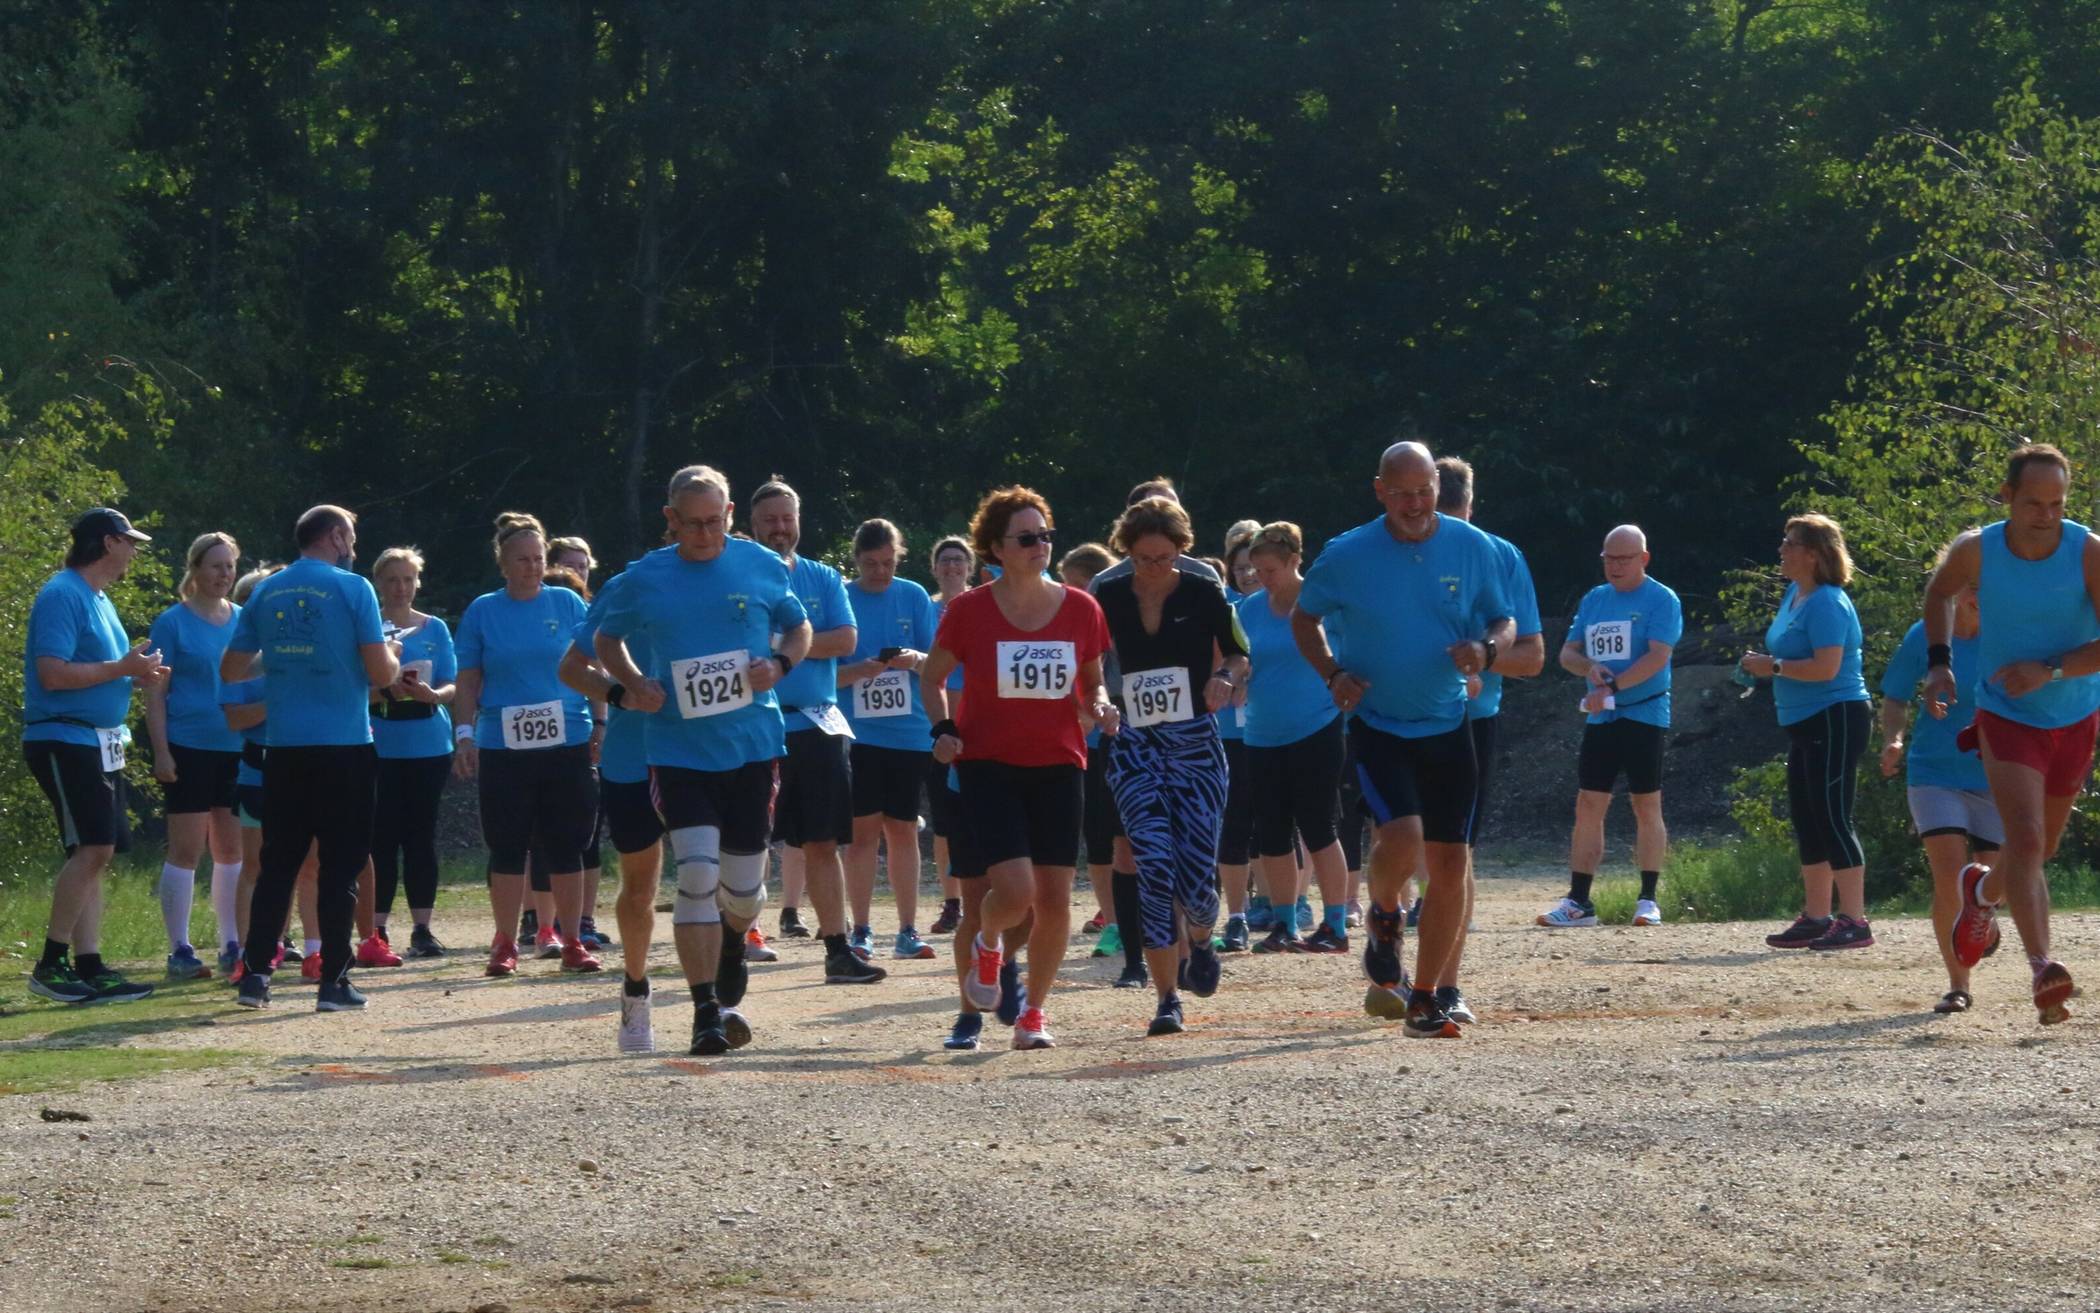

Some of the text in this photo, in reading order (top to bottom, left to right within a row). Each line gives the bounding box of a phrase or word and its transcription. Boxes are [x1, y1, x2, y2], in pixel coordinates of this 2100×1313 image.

[1030, 648, 1063, 660] asics
[1592, 635, 1624, 656] 1918
[702, 659, 735, 675] asics
[1010, 662, 1067, 690] 1915
[685, 672, 744, 708] 1924
[874, 676, 900, 687] asics
[1144, 674, 1174, 688] asics
[861, 687, 905, 711] 1930
[1132, 686, 1181, 718] 1997
[526, 707, 553, 719] asics
[512, 718, 559, 742] 1926
